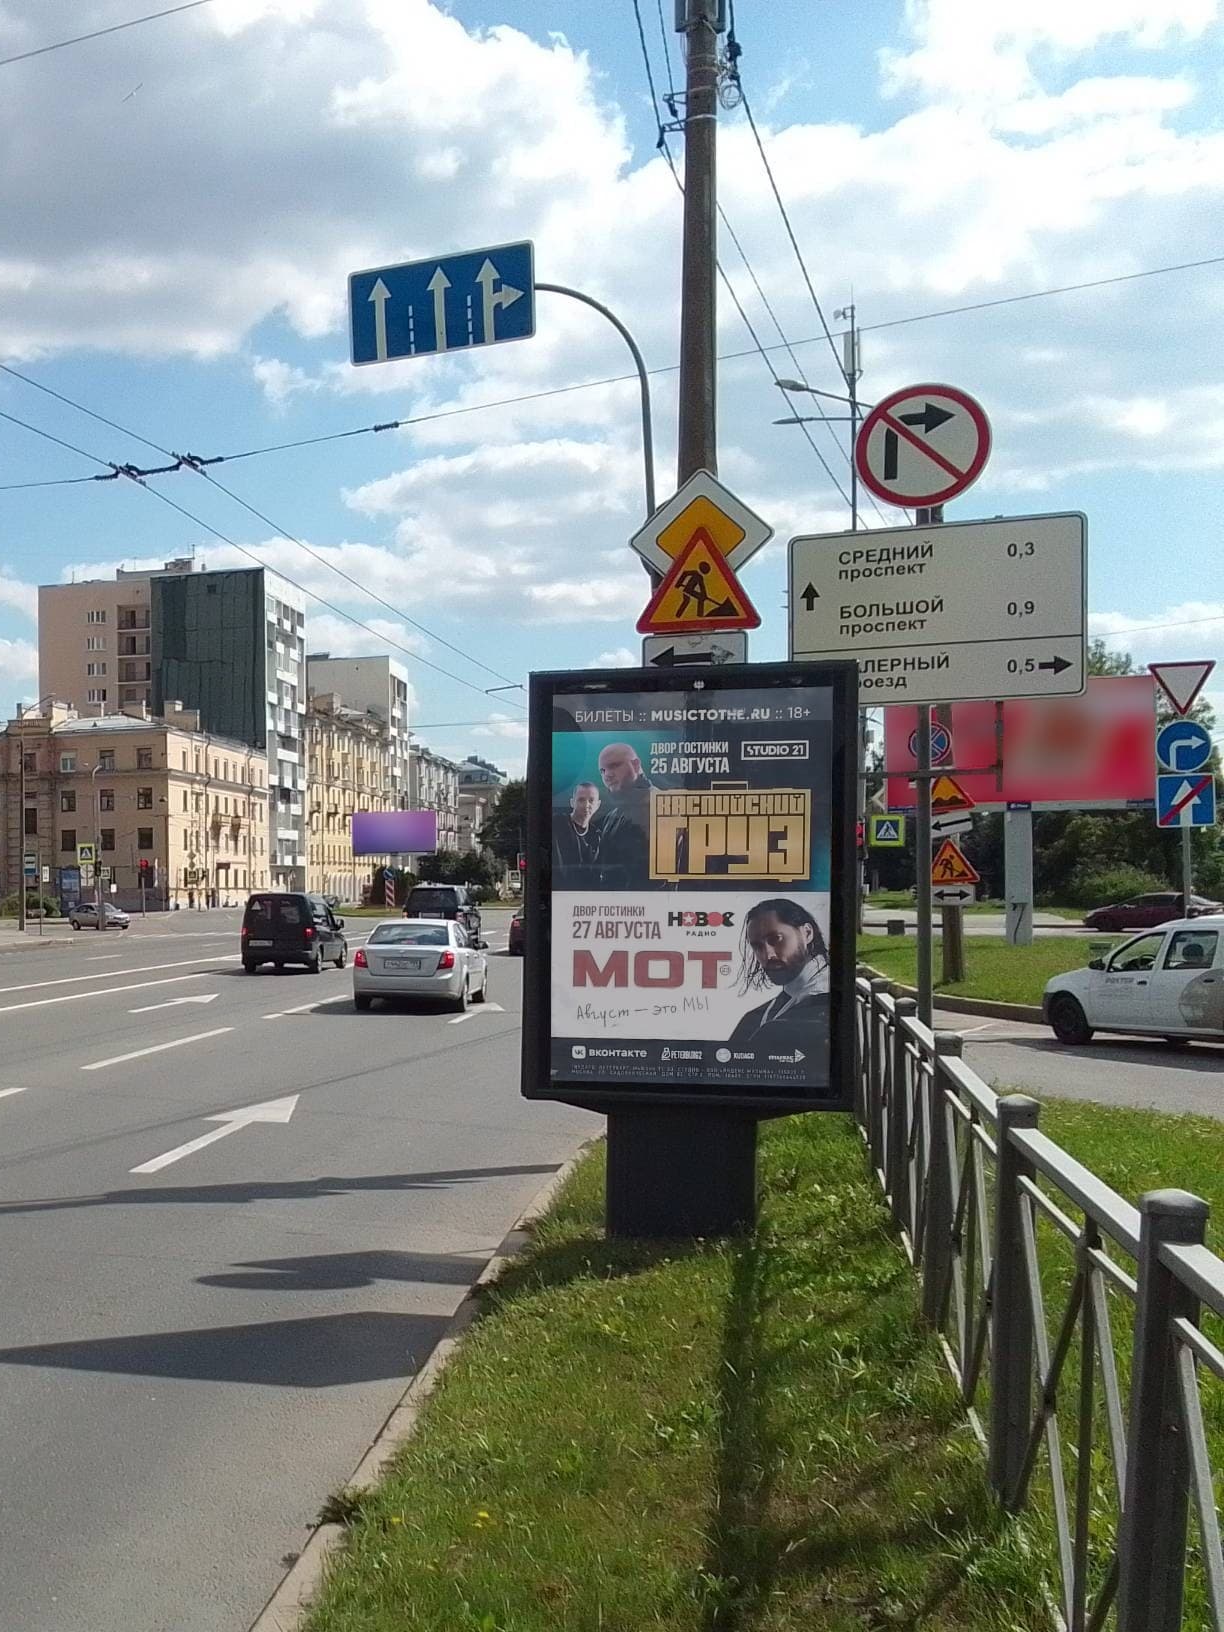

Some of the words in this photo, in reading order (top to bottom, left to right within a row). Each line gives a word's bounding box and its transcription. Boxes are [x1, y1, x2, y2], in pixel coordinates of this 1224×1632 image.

[838, 541, 934, 565] СРЕДНИЙ
[1007, 542, 1035, 559] 0,3
[838, 562, 927, 582] проспект
[840, 595, 944, 619] БОЛЬШОЙ
[1007, 601, 1035, 617] 0,9
[839, 618, 927, 637] проспект
[858, 651, 950, 674] ЛЕРНЫЙ
[1007, 658, 1035, 675] 0,5
[858, 676, 907, 689] оезд
[575, 709, 634, 723] БИЛЕТЫ
[651, 707, 770, 721] MUSICTOTHE.RU
[787, 706, 811, 719] 18+
[650, 742, 677, 755] ДВОР
[679, 742, 729, 754] ГОСТИНКИ
[746, 745, 789, 756] STUDIO
[792, 745, 804, 755] 21
[650, 758, 667, 774] 25
[671, 757, 730, 774] АВГУСТА
[656, 794, 805, 815] КАСПИЙСКИЙ
[656, 815, 804, 874] ГРУЗ
[573, 905, 596, 918] ДВОР
[598, 905, 645, 917] ГОСТИНКИ
[573, 921, 592, 939] 27
[595, 921, 661, 940] АВГУСТА
[573, 949, 732, 989] МОТ
[576, 1003, 629, 1028] Август
[653, 1005, 677, 1015] это
[683, 996, 709, 1013] МЫ
